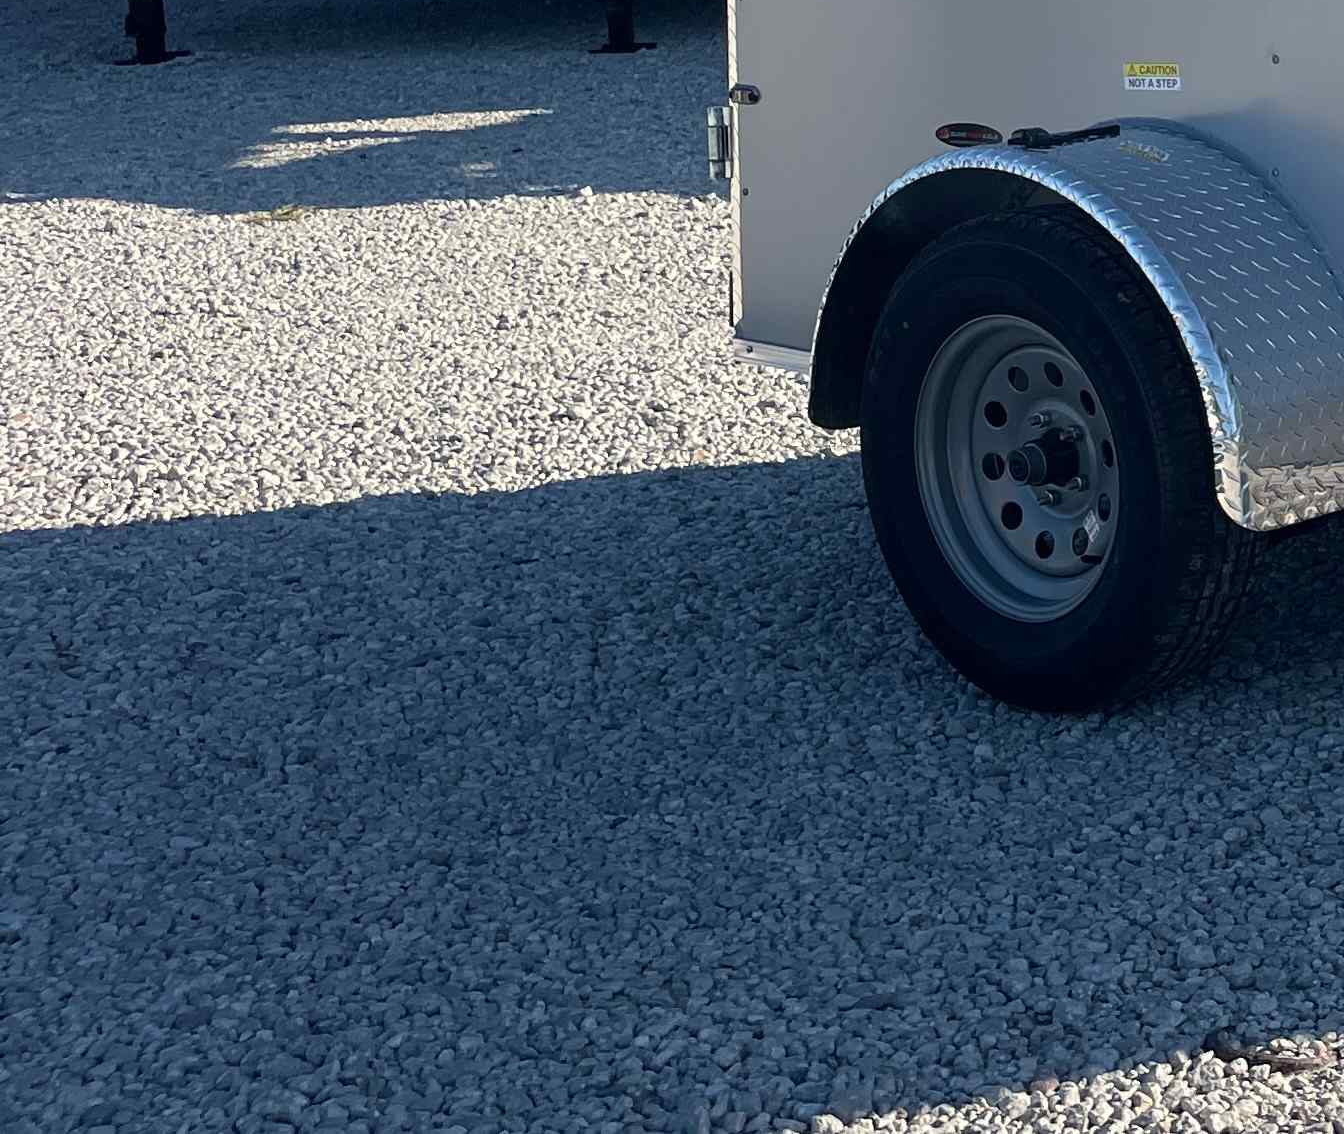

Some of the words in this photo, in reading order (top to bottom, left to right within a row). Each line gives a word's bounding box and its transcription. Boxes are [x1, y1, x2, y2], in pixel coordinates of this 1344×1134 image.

[1139, 65, 1177, 75] CAUTION
[1128, 78, 1146, 88] NOT
[1147, 78, 1155, 88] A
[1156, 78, 1178, 88] STEP
